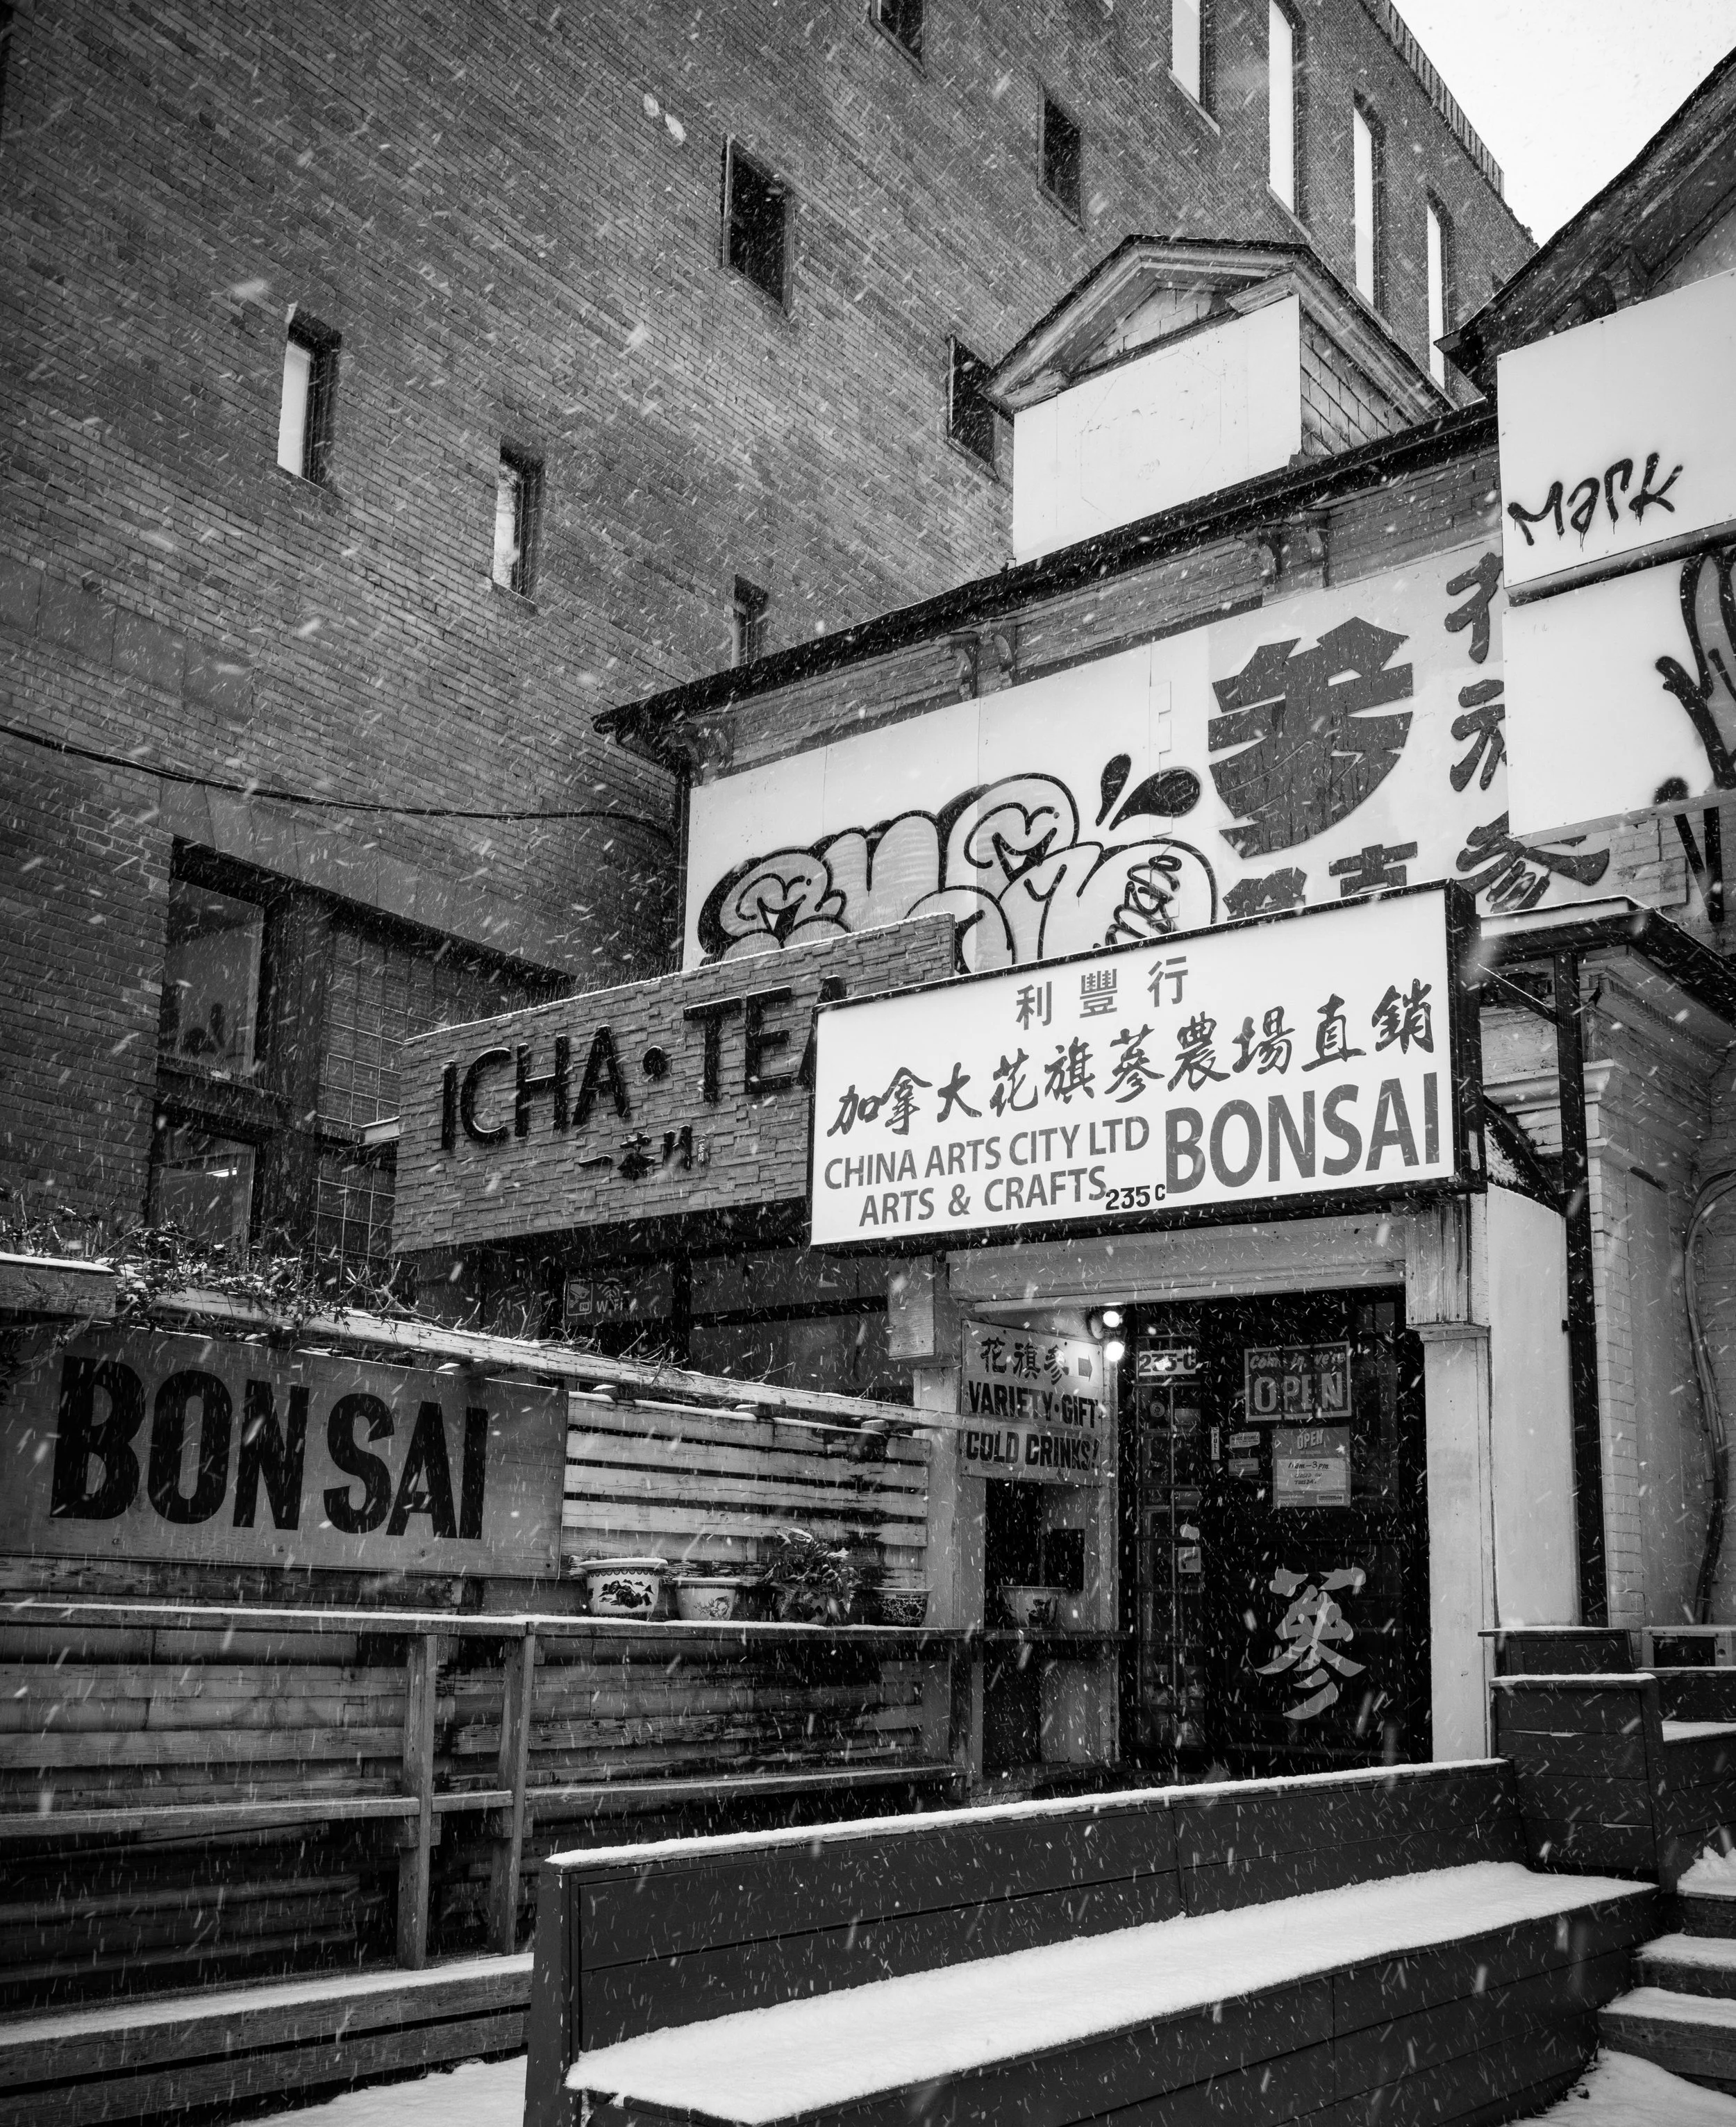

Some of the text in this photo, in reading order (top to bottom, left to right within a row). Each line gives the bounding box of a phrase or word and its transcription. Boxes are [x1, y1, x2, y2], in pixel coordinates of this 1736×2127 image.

[1016, 956, 1188, 1031] 利豐行
[441, 1025, 631, 1150] ICHA
[825, 1117, 1149, 1189] CHINA ARTS CITY LTD
[1166, 1072, 1439, 1194] BONSAI
[860, 1188, 935, 1226] ARTS
[949, 1184, 971, 1216] &
[985, 1166, 1106, 1212] CRAFTS
[1254, 1372, 1343, 1412] OPEN
[49, 1355, 489, 1540] BONSAI
[966, 1430, 1100, 1471] COLD DRINKS!
[1296, 1429, 1324, 1450] OPEN
